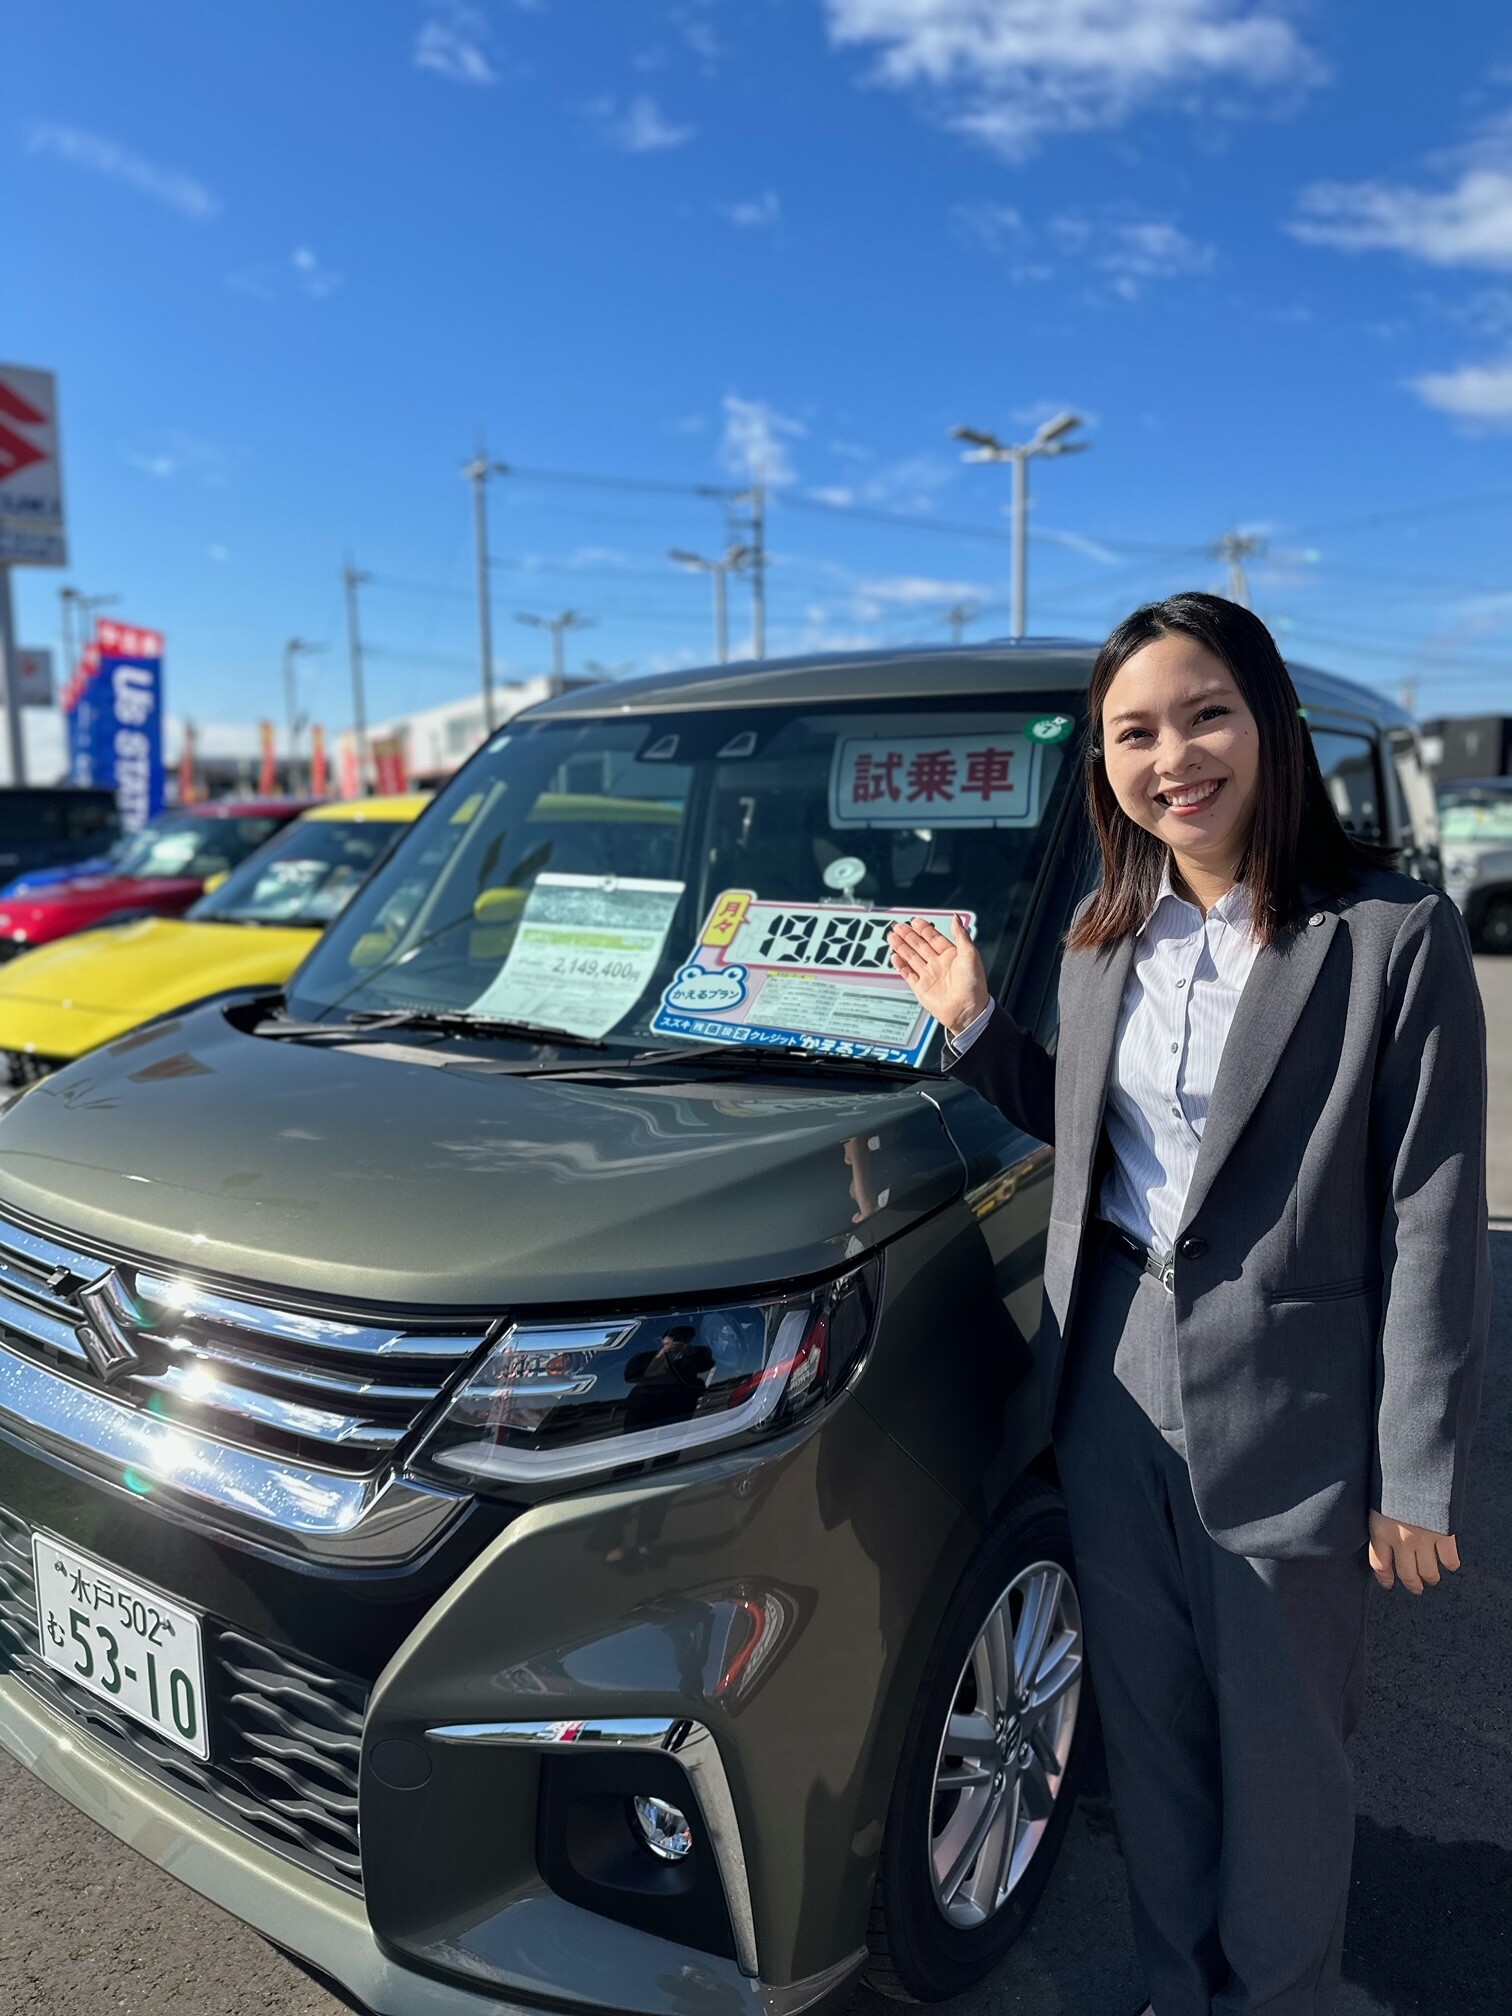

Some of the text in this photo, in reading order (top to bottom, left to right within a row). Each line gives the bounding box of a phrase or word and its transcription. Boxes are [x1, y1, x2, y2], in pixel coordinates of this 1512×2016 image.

[852, 747, 1015, 804] 試乗車
[713, 901, 741, 934] 月々
[759, 914, 935, 969] 19,80
[672, 988, 739, 1000] かえるプラン
[47, 1607, 197, 1741] む 53-10
